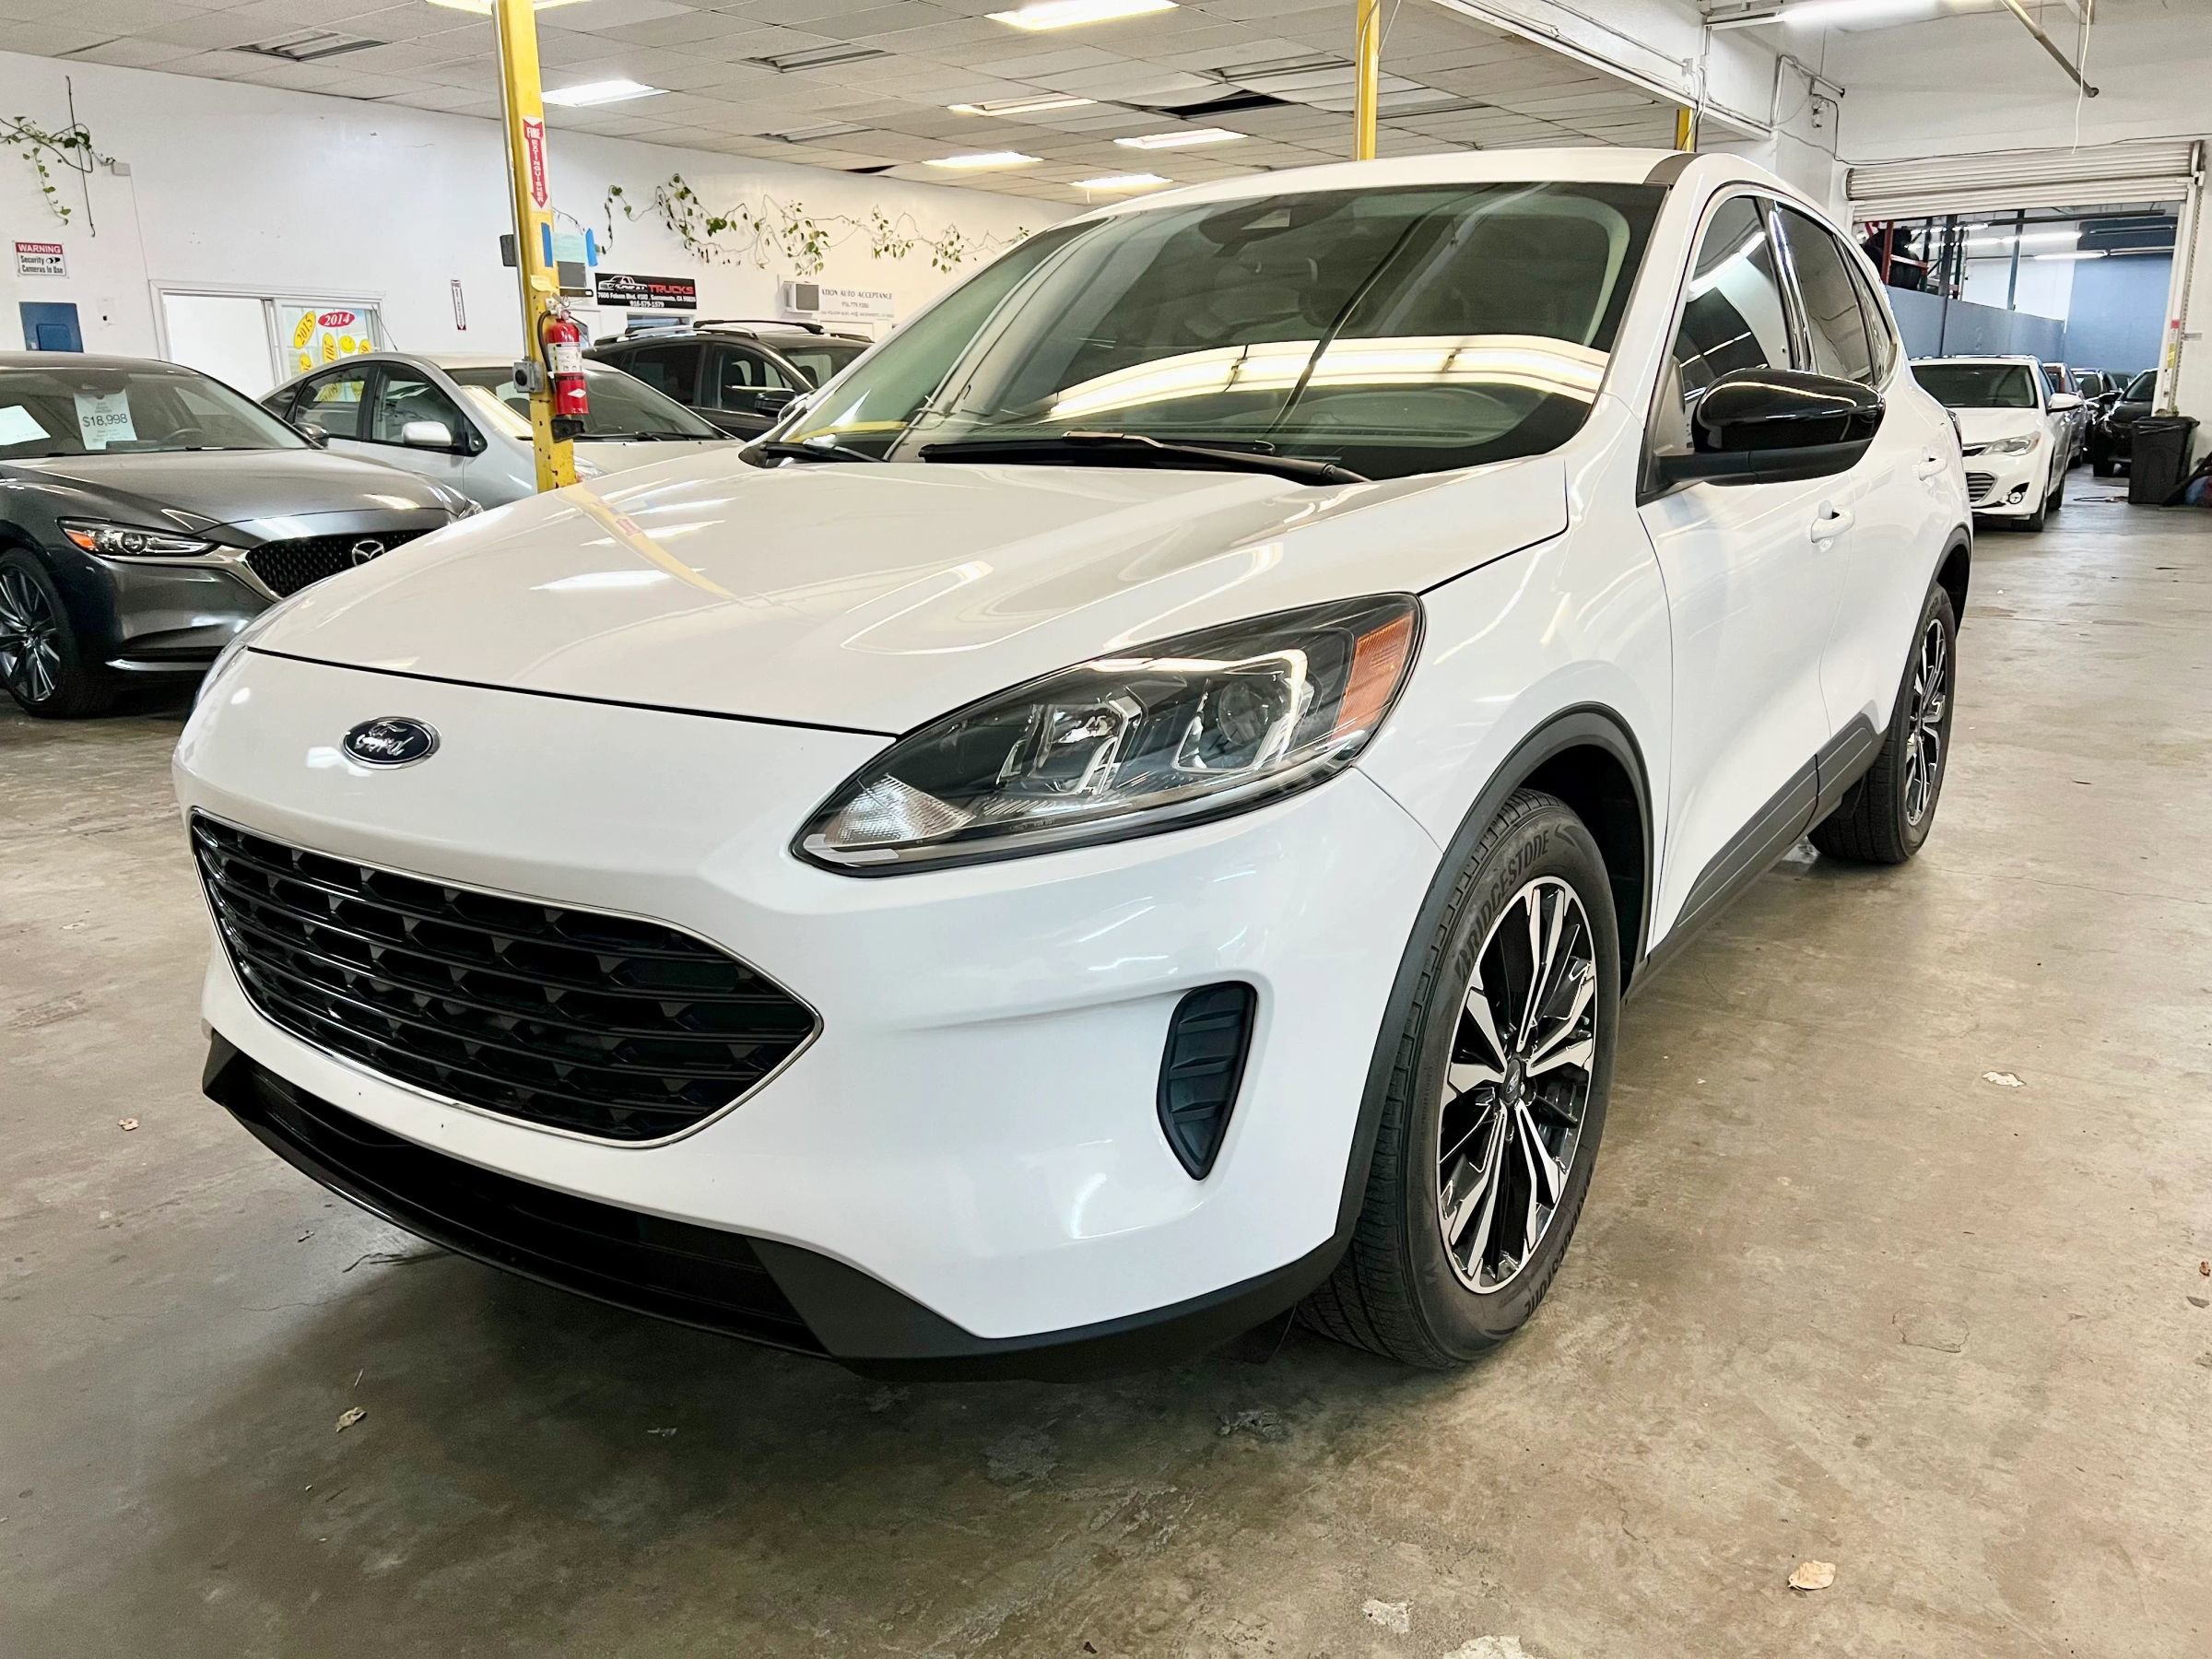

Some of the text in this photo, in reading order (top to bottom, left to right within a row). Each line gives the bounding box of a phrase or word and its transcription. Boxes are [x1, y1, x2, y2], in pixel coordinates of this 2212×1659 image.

[526, 127, 542, 140] FIRE
[532, 139, 544, 202] EXTINGUISHER
[18, 243, 62, 253] WARNING
[20, 254, 44, 265] Security
[648, 284, 694, 295] TRUCKS
[841, 289, 855, 298] AUTO
[857, 290, 892, 300] ACCEPTANCE
[324, 313, 350, 326] 2014
[297, 314, 312, 346] 2015
[324, 340, 335, 361] 201
[82, 413, 128, 428] $18,998
[353, 722, 414, 757] Ford
[1453, 830, 1550, 985] BRIDGESTONE
